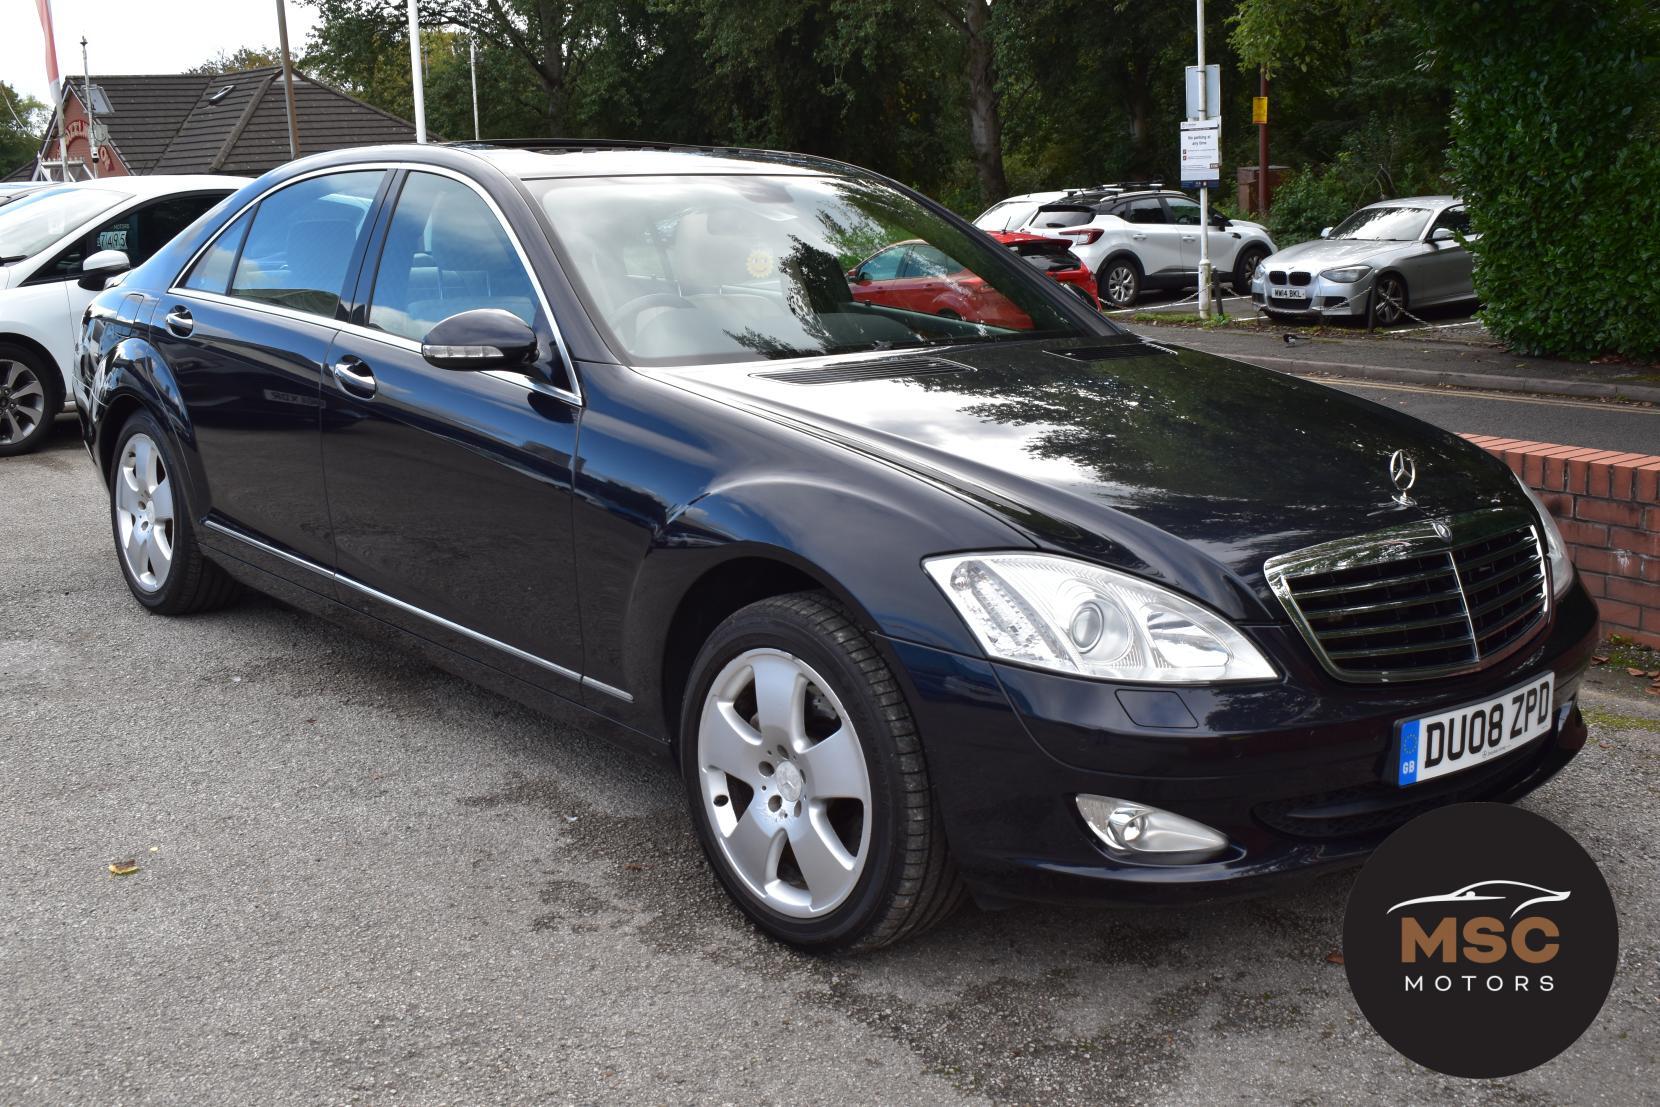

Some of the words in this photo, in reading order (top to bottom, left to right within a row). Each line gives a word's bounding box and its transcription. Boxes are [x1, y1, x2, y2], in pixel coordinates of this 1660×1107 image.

[1424, 702, 1504, 769] DU08
[1509, 680, 1550, 740] ZPD
[1402, 760, 1415, 774] GB
